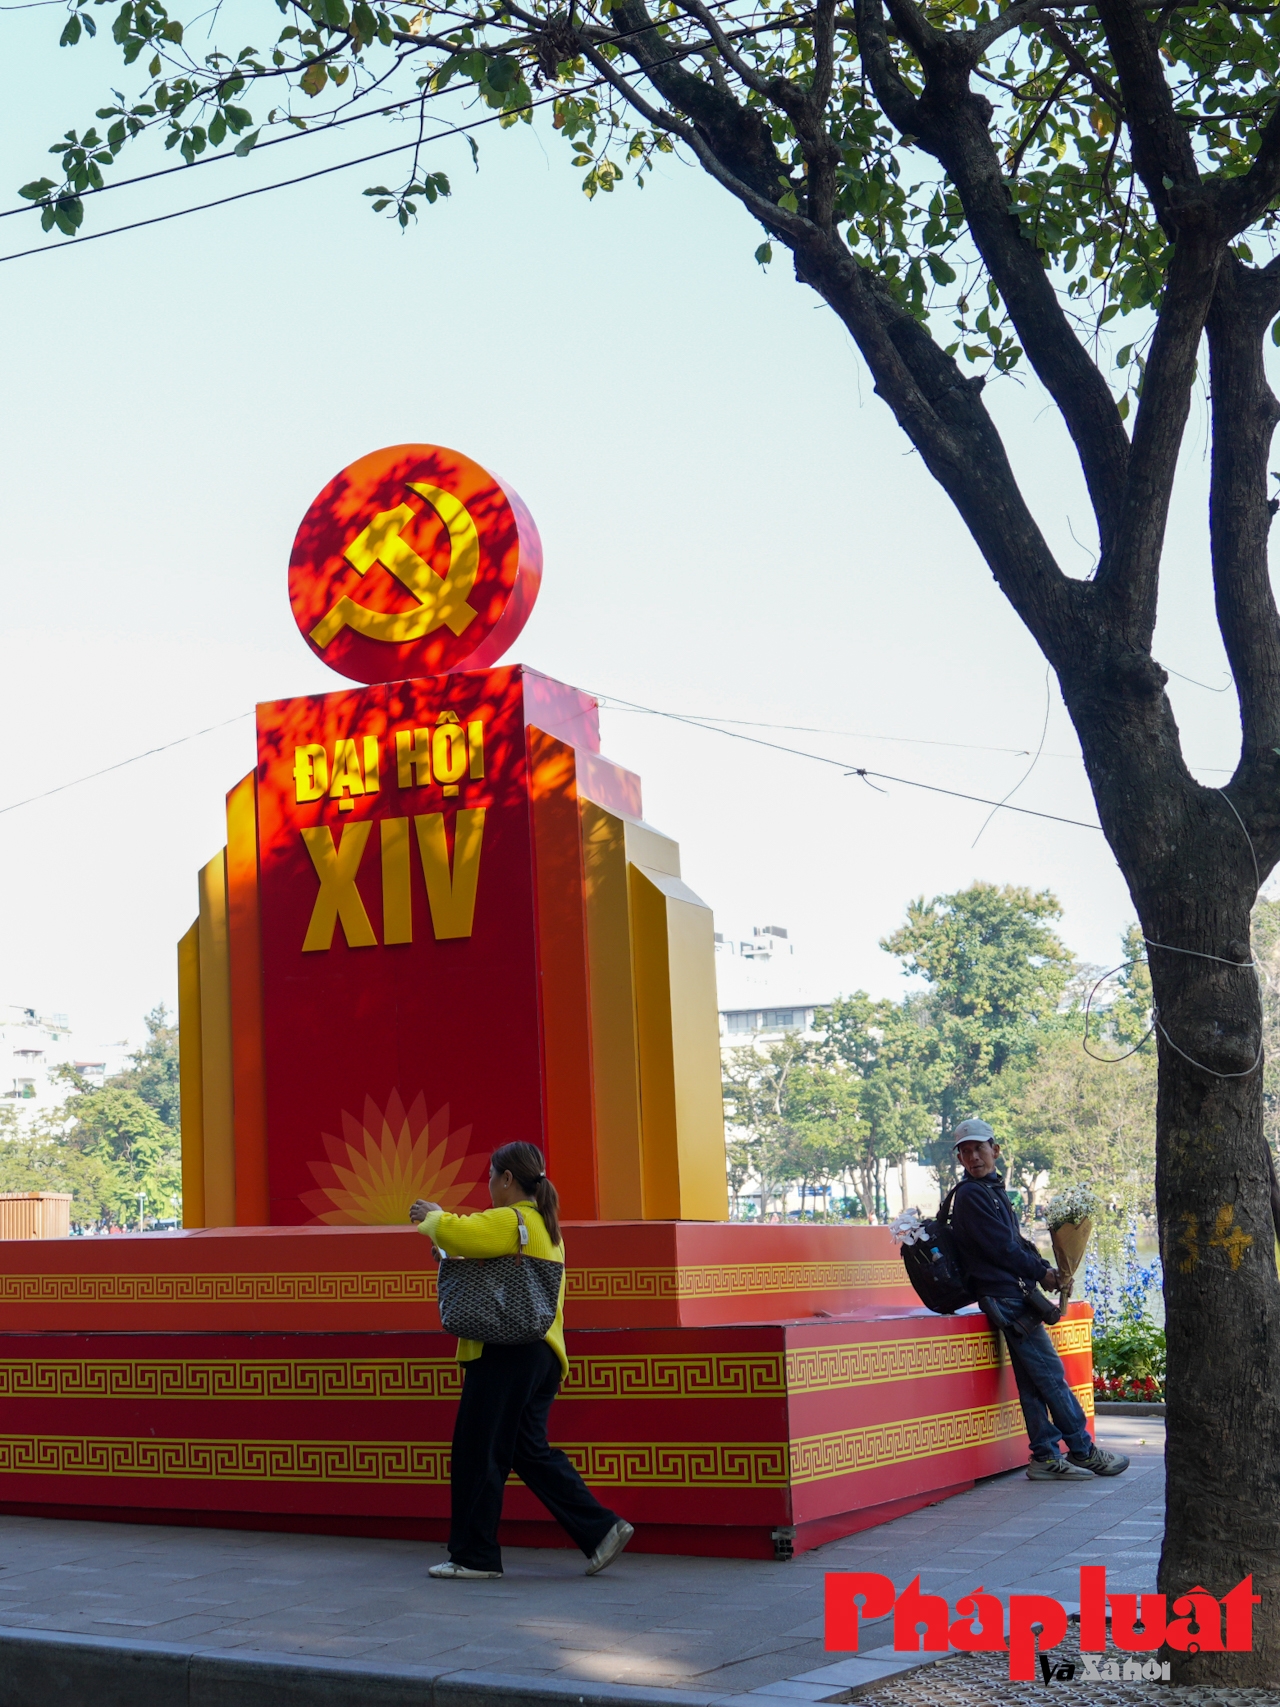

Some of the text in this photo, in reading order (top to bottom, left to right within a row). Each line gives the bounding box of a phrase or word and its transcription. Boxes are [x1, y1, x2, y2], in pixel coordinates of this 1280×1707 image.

[293, 710, 485, 811] ĐẠI HỘI
[300, 807, 486, 952] XIV
